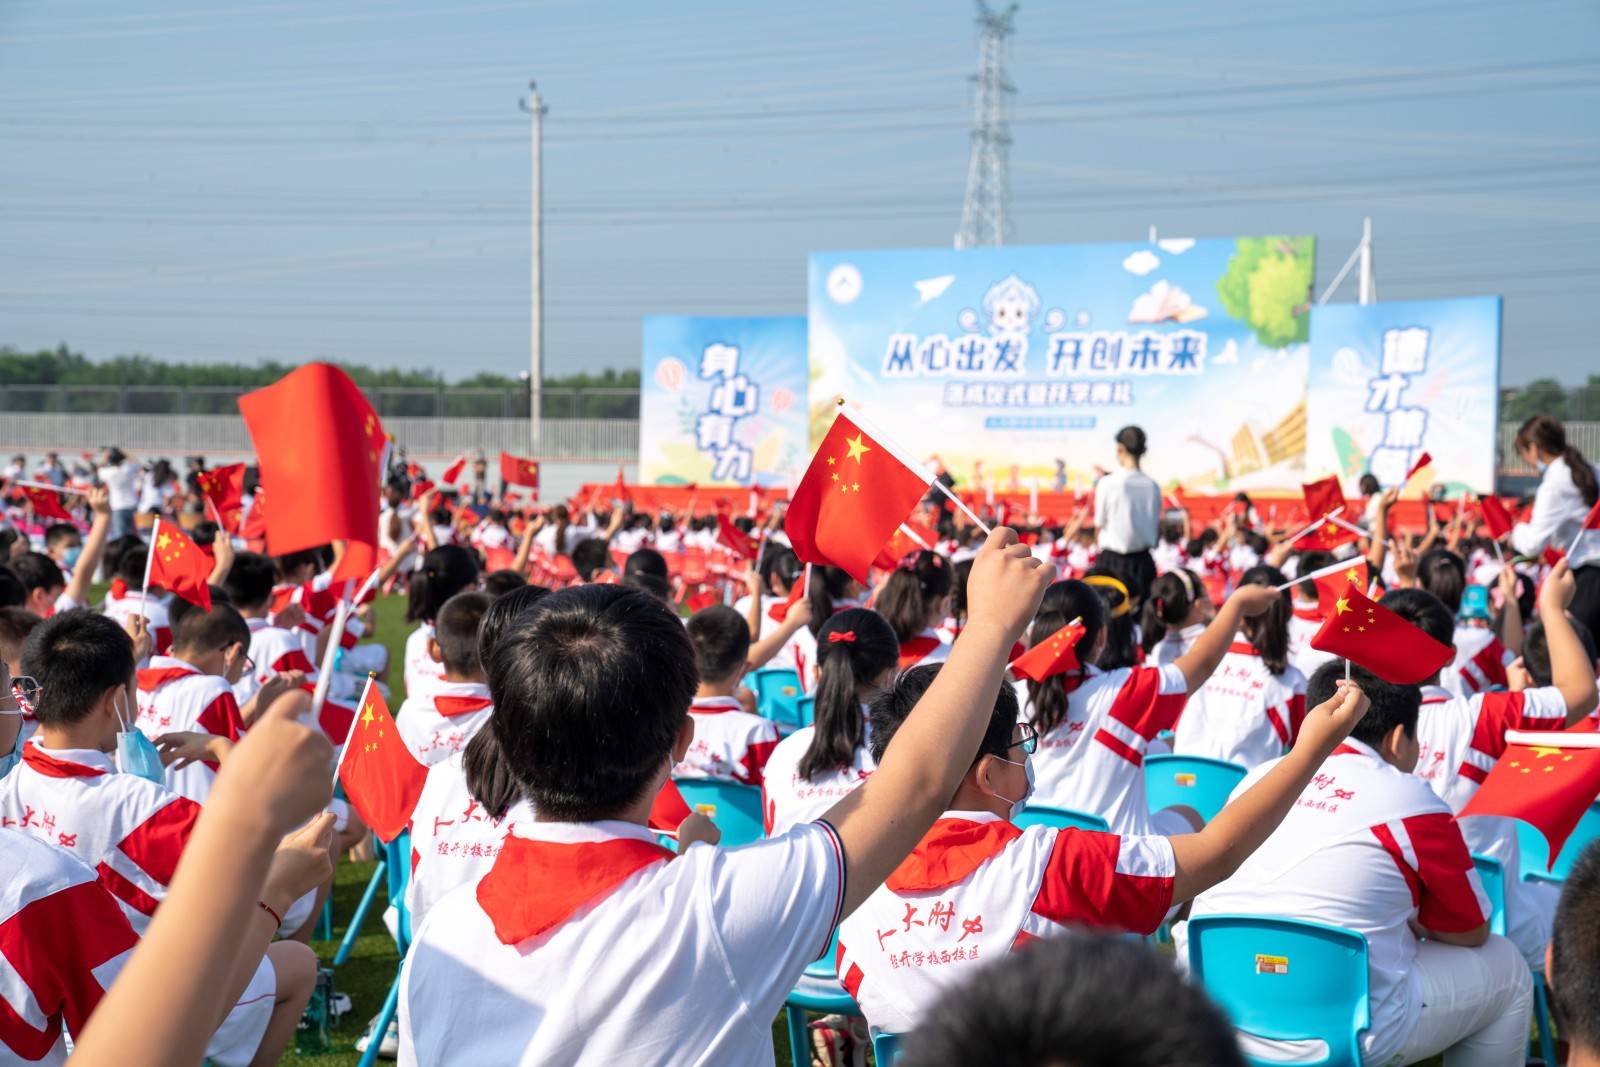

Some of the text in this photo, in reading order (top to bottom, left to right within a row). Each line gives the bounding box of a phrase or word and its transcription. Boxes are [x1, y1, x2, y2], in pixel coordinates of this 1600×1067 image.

[884, 333, 1204, 374] 从心出发 开创未来
